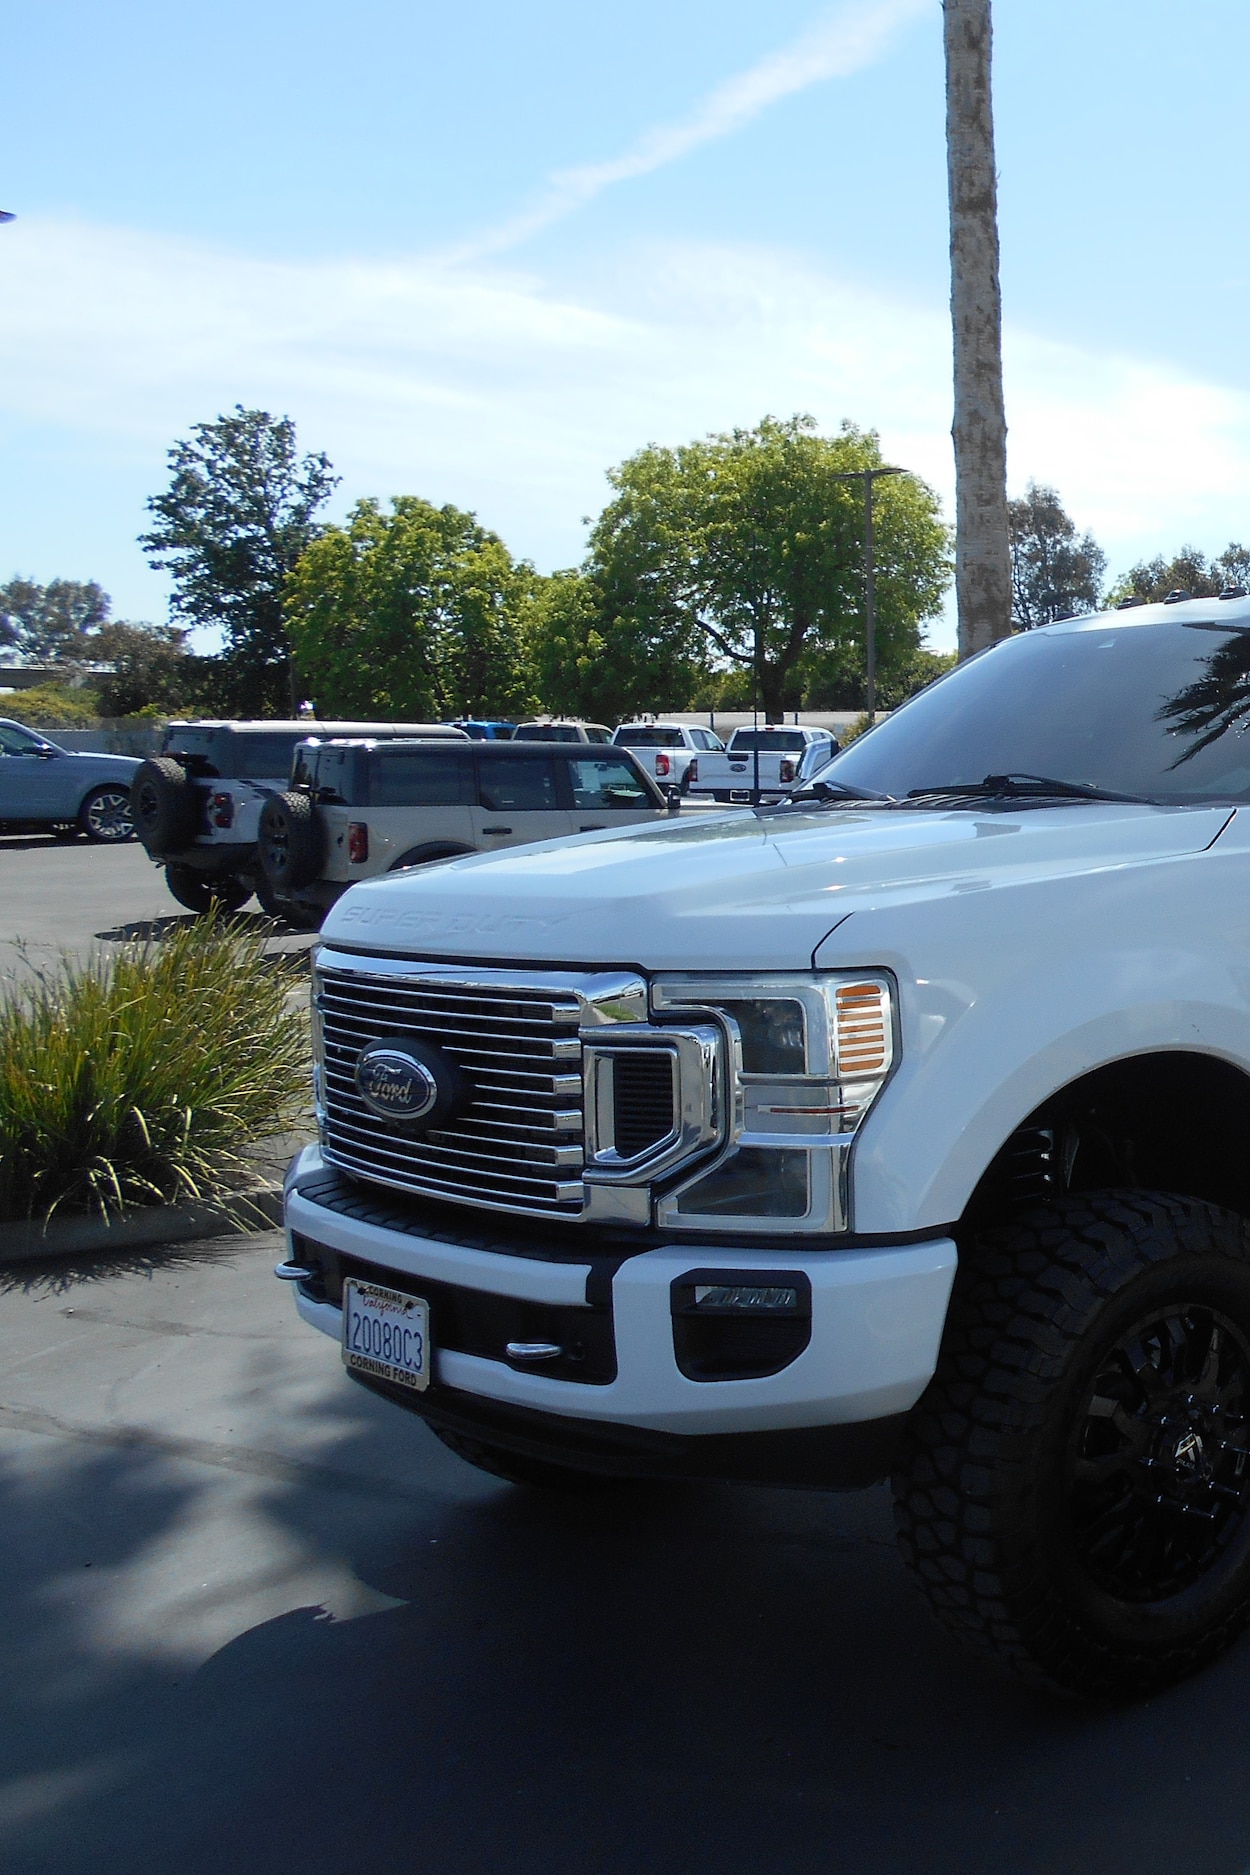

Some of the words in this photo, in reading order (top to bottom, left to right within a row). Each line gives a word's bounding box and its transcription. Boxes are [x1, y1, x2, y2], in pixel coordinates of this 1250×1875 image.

[340, 905, 440, 930] SUPER
[365, 1063, 413, 1104] Ford
[353, 1312, 423, 1370] 20080C3
[350, 1354, 391, 1378] CORNING
[392, 1367, 417, 1387] FORD
